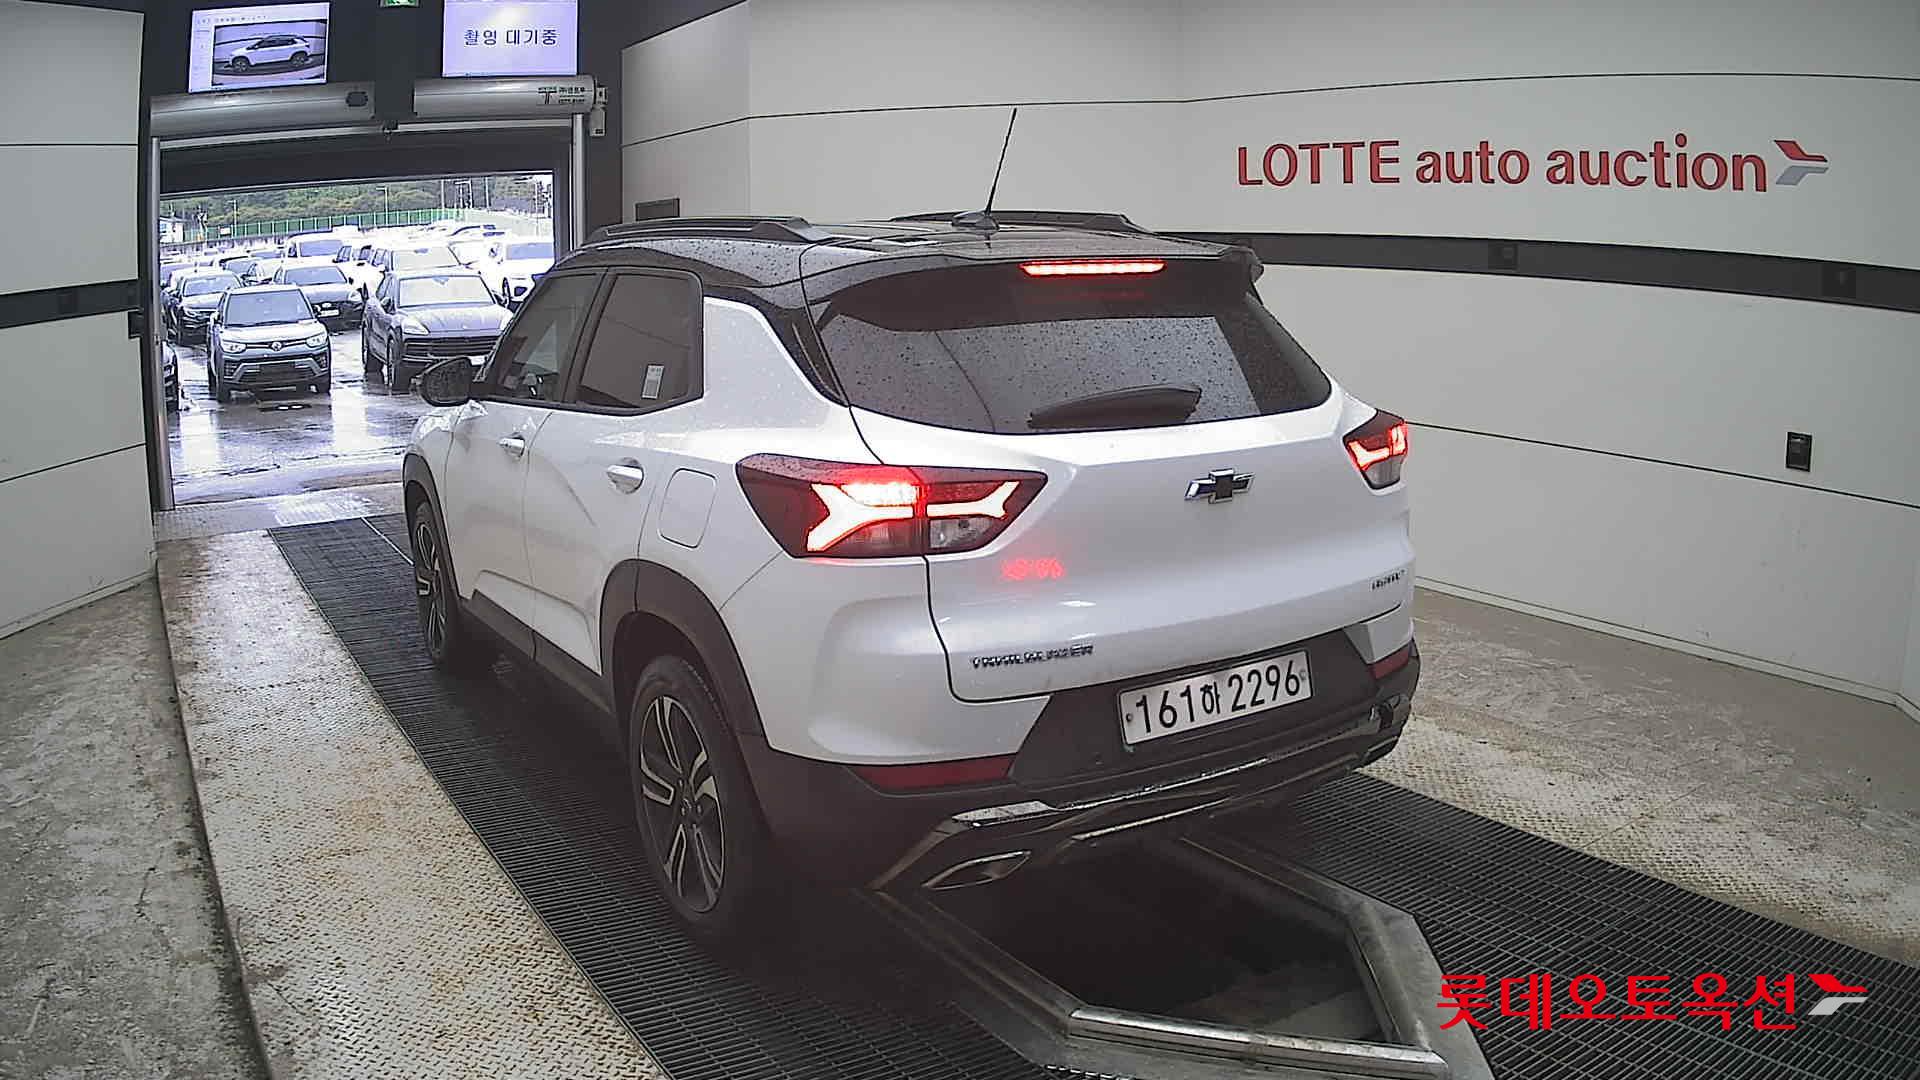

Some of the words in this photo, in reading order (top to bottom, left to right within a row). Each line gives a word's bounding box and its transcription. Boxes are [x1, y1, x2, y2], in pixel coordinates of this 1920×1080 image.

[505, 28, 559, 46] 대기중
[1238, 140, 1400, 186] LOTTE
[1415, 140, 1530, 185] auto
[1546, 132, 1767, 192] auction
